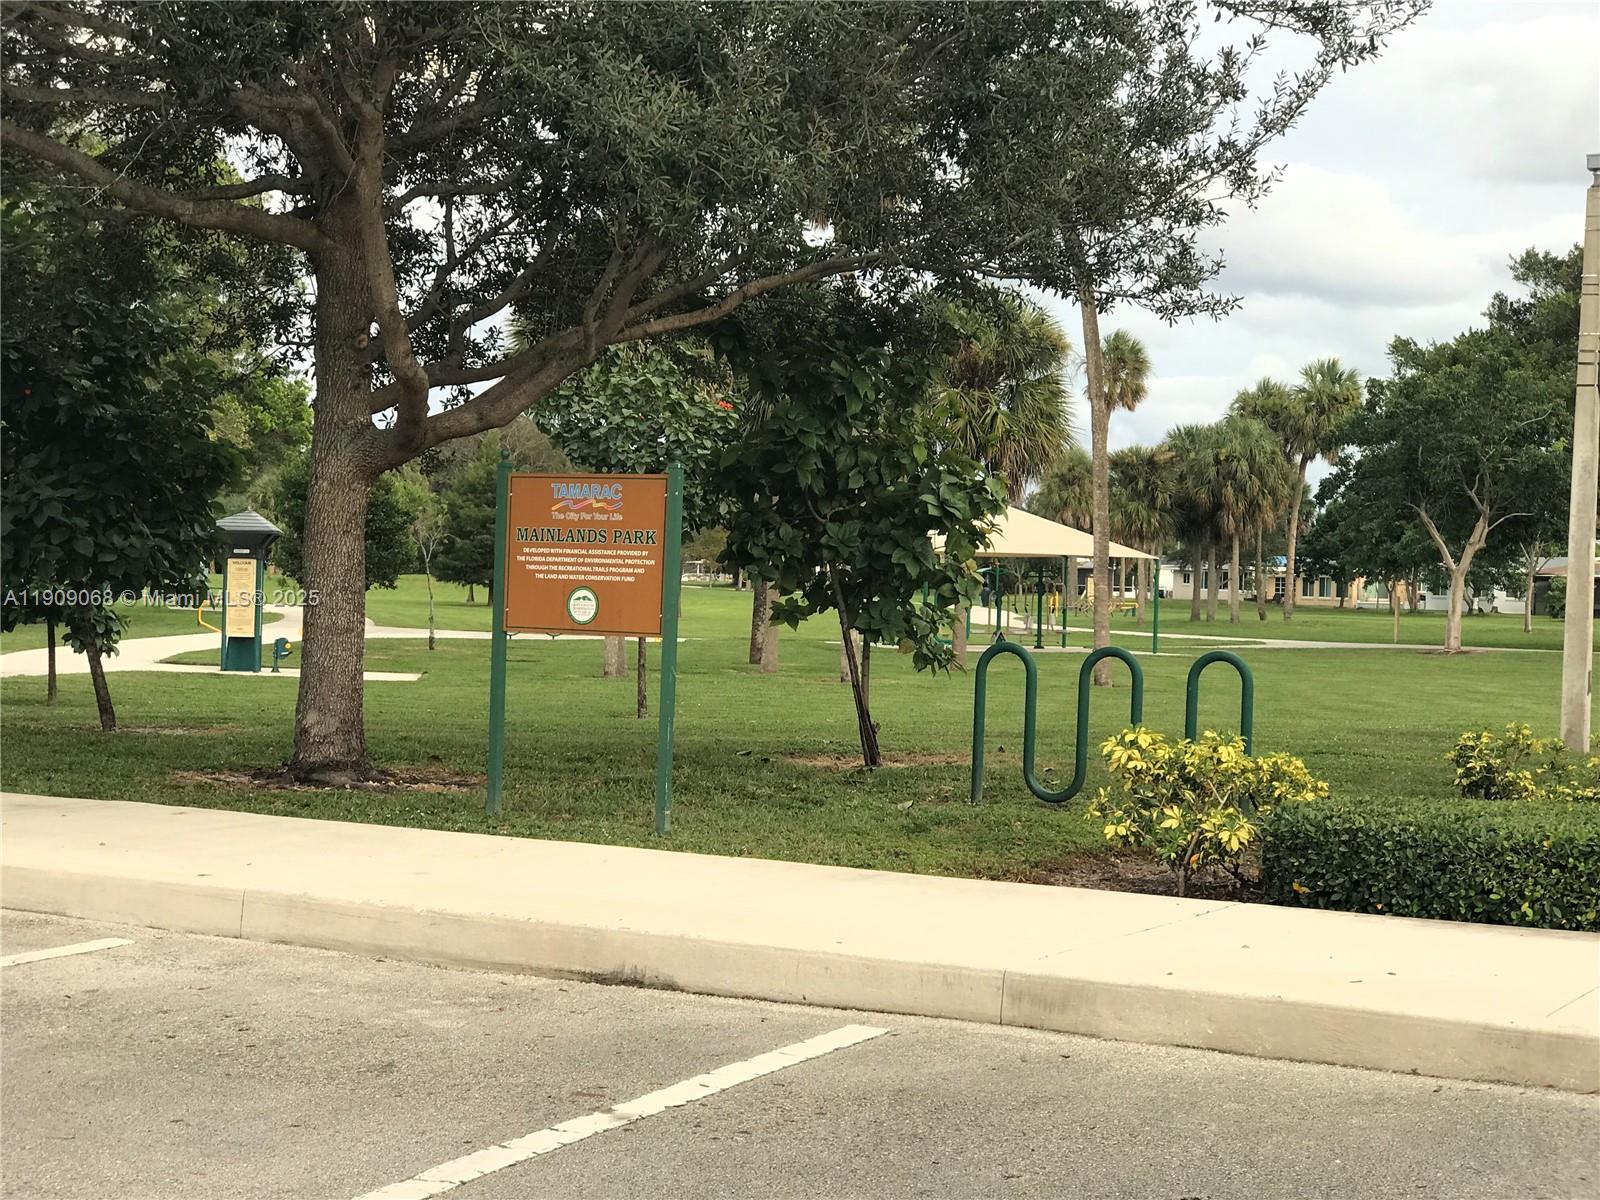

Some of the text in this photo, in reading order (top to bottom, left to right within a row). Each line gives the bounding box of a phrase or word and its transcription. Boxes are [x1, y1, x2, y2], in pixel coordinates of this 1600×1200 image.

[551, 483, 622, 500] TAMARAC
[565, 512, 579, 521] City
[516, 527, 657, 545] MAINLANDS PARK
